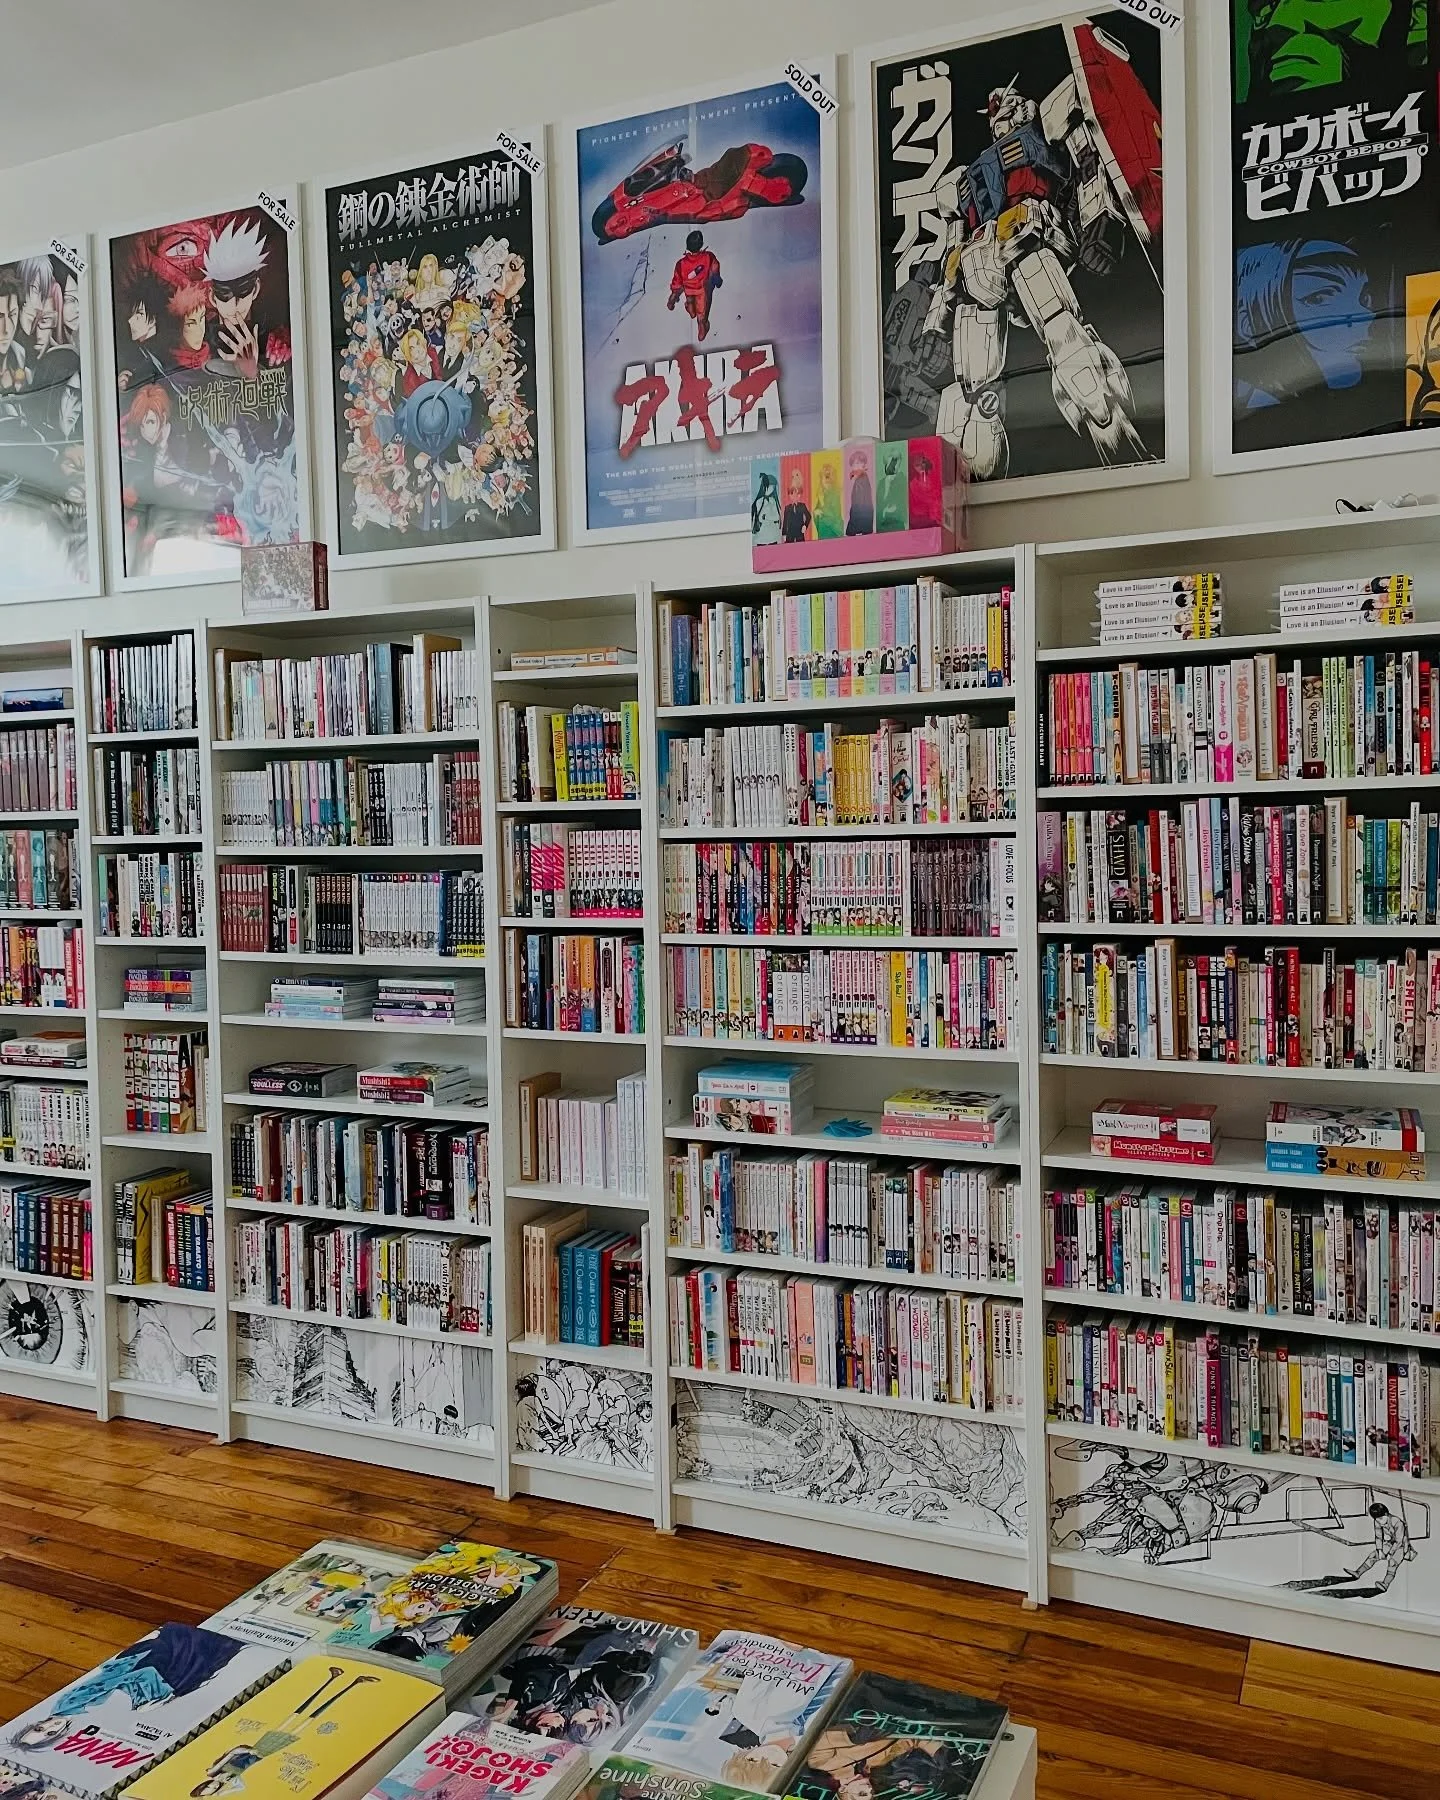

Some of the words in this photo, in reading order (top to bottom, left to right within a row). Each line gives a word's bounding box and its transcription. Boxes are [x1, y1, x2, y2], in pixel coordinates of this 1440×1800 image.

[1148, 6, 1181, 29] OUT
[784, 64, 812, 93] SOLD
[811, 86, 836, 114] OUT
[645, 107, 737, 136] ENTERTAINMENT
[744, 91, 804, 112] PRESENT
[1241, 90, 1427, 168] カウボーイ
[496, 132, 517, 152] FOR
[516, 149, 540, 172] SALE
[1256, 150, 1342, 176] COWBOY
[1346, 137, 1413, 159] BEBOP
[1246, 144, 1428, 221] ビバップ
[258, 192, 276, 211] FOR
[274, 208, 296, 230] SALE
[338, 160, 521, 242] 鋼の錬金術師
[340, 230, 423, 252] FULLMETAL
[432, 208, 522, 233] ALCHEMIST
[50, 240, 67, 256] FOR
[65, 250, 86, 272] SALE
[619, 344, 783, 450] AKIRA
[1102, 586, 1115, 594] Love
[1283, 589, 1297, 597] Love
[1104, 602, 1117, 610] Love
[1283, 605, 1297, 613] Love
[1104, 618, 1117, 626] Love
[1286, 621, 1300, 629] Love
[1299, 818, 1307, 829] No
[1213, 828, 1222, 870] Boyfriends
[1272, 820, 1280, 855] SEMANTIC
[1299, 829, 1307, 847] Love
[1005, 845, 1014, 860] LOVE
[1112, 834, 1126, 876] SHWD
[1202, 829, 1211, 873] Boyfriends
[1299, 848, 1307, 866] Zone
[1005, 868, 1014, 884] FOCUS
[1272, 854, 1280, 877] ERROR
[775, 974, 785, 1012] orange
[789, 974, 799, 1012] orange
[1404, 979, 1415, 1024] SMELL
[361, 1090, 388, 1099] Mushishi
[427, 1133, 439, 1175] NORAGAMI
[1216, 1227, 1224, 1243] Drip
[440, 1262, 450, 1298] witches
[1292, 1273, 1301, 1294] PARTY
[1209, 1365, 1217, 1390] PUNKS
[1388, 1378, 1398, 1416] UNDEAD
[1209, 1395, 1217, 1430] TRIANGLE
[408, 1578, 445, 1596] GIRL
[422, 1572, 500, 1596] DANDELION
[446, 1586, 501, 1606] MAGICAL
[548, 1604, 602, 1628] REN
[229, 1624, 269, 1640] Railways
[268, 1633, 299, 1648] Maiden
[616, 1620, 697, 1648] SHINO
[724, 1644, 831, 1684] Innocent
[732, 1657, 749, 1667] Too
[753, 1662, 778, 1673] Just
[742, 1668, 784, 1688] Lover
[782, 1670, 794, 1680] Is
[786, 1680, 815, 1696] My
[136, 1721, 162, 1734] YAZAWA
[54, 1728, 154, 1769] NANA
[426, 1752, 532, 1794] KAGEKI
[600, 1768, 708, 1799] Sunshine
